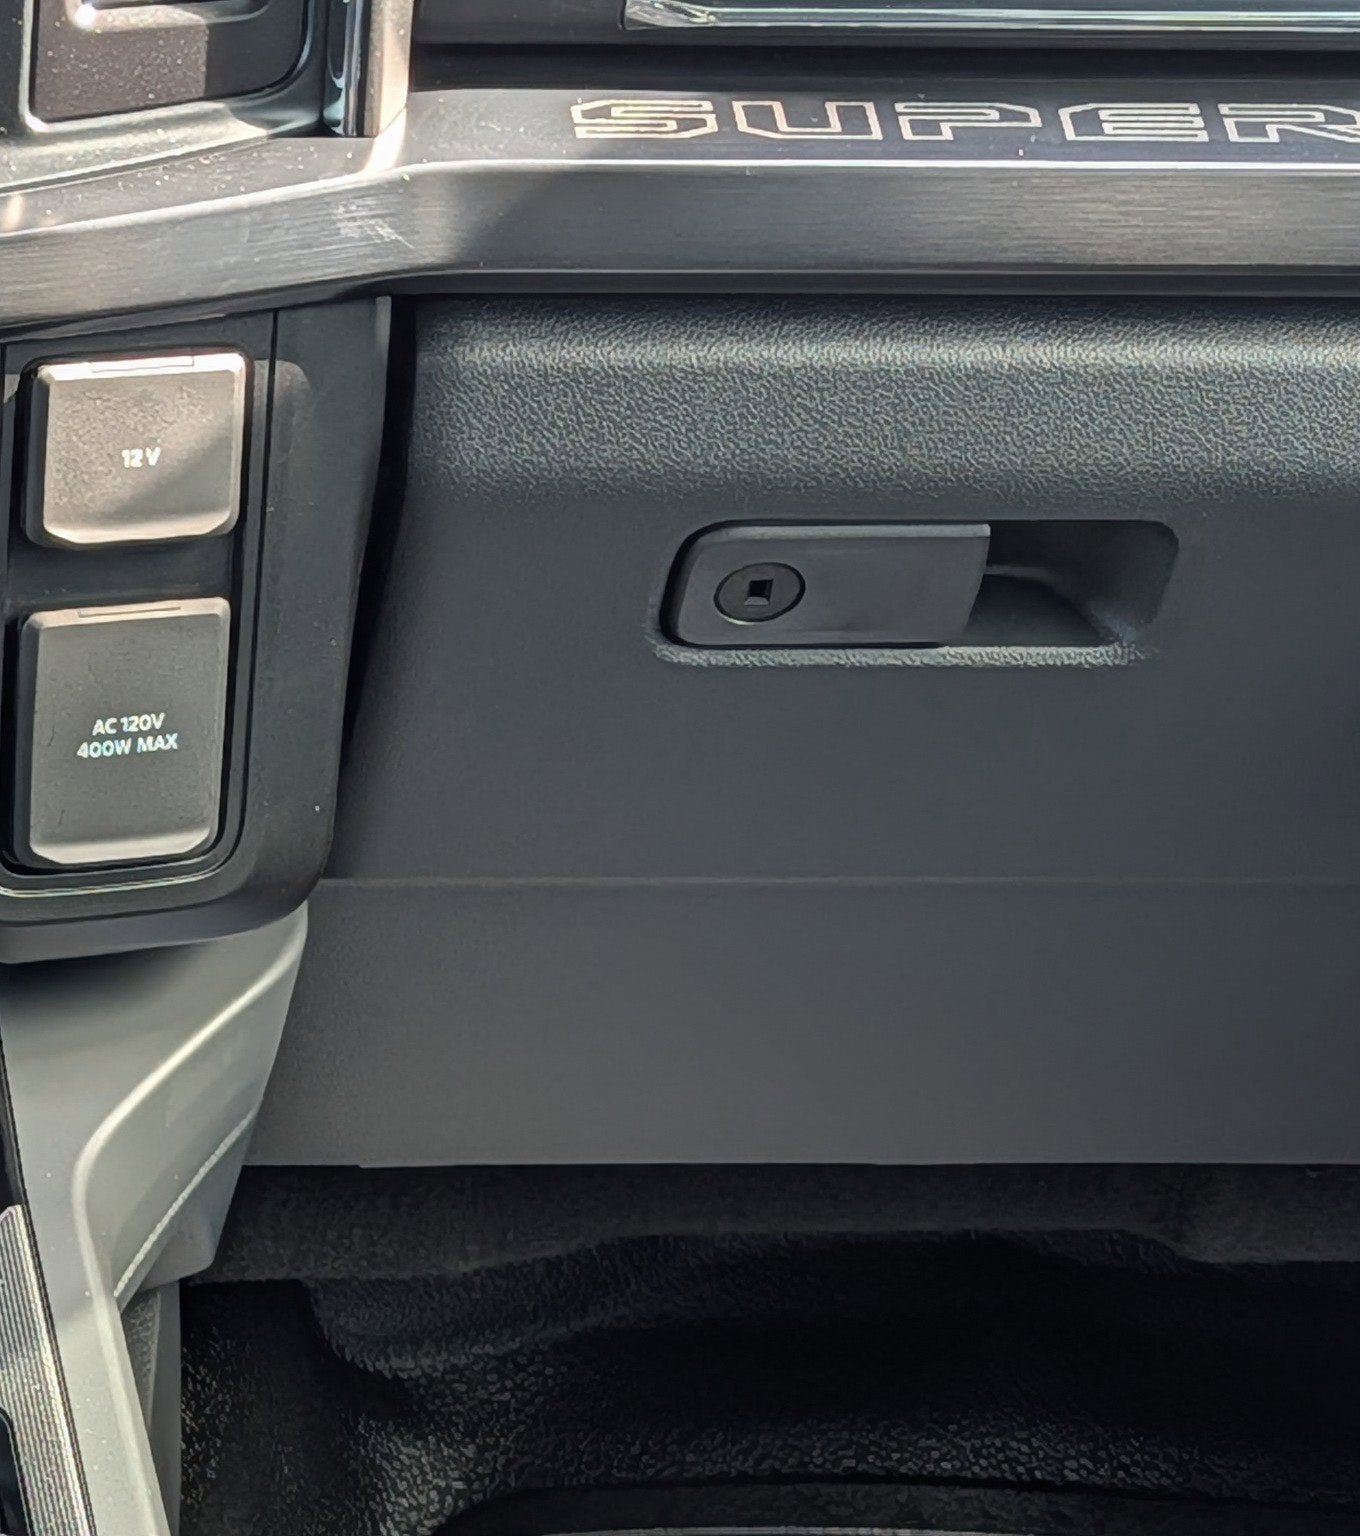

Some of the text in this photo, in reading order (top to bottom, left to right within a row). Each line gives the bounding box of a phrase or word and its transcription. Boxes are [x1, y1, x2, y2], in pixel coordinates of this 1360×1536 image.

[570, 98, 1360, 144] SUPER
[121, 450, 144, 468] 12
[92, 713, 166, 735] AC 120V
[76, 732, 179, 759] 400W MAX
